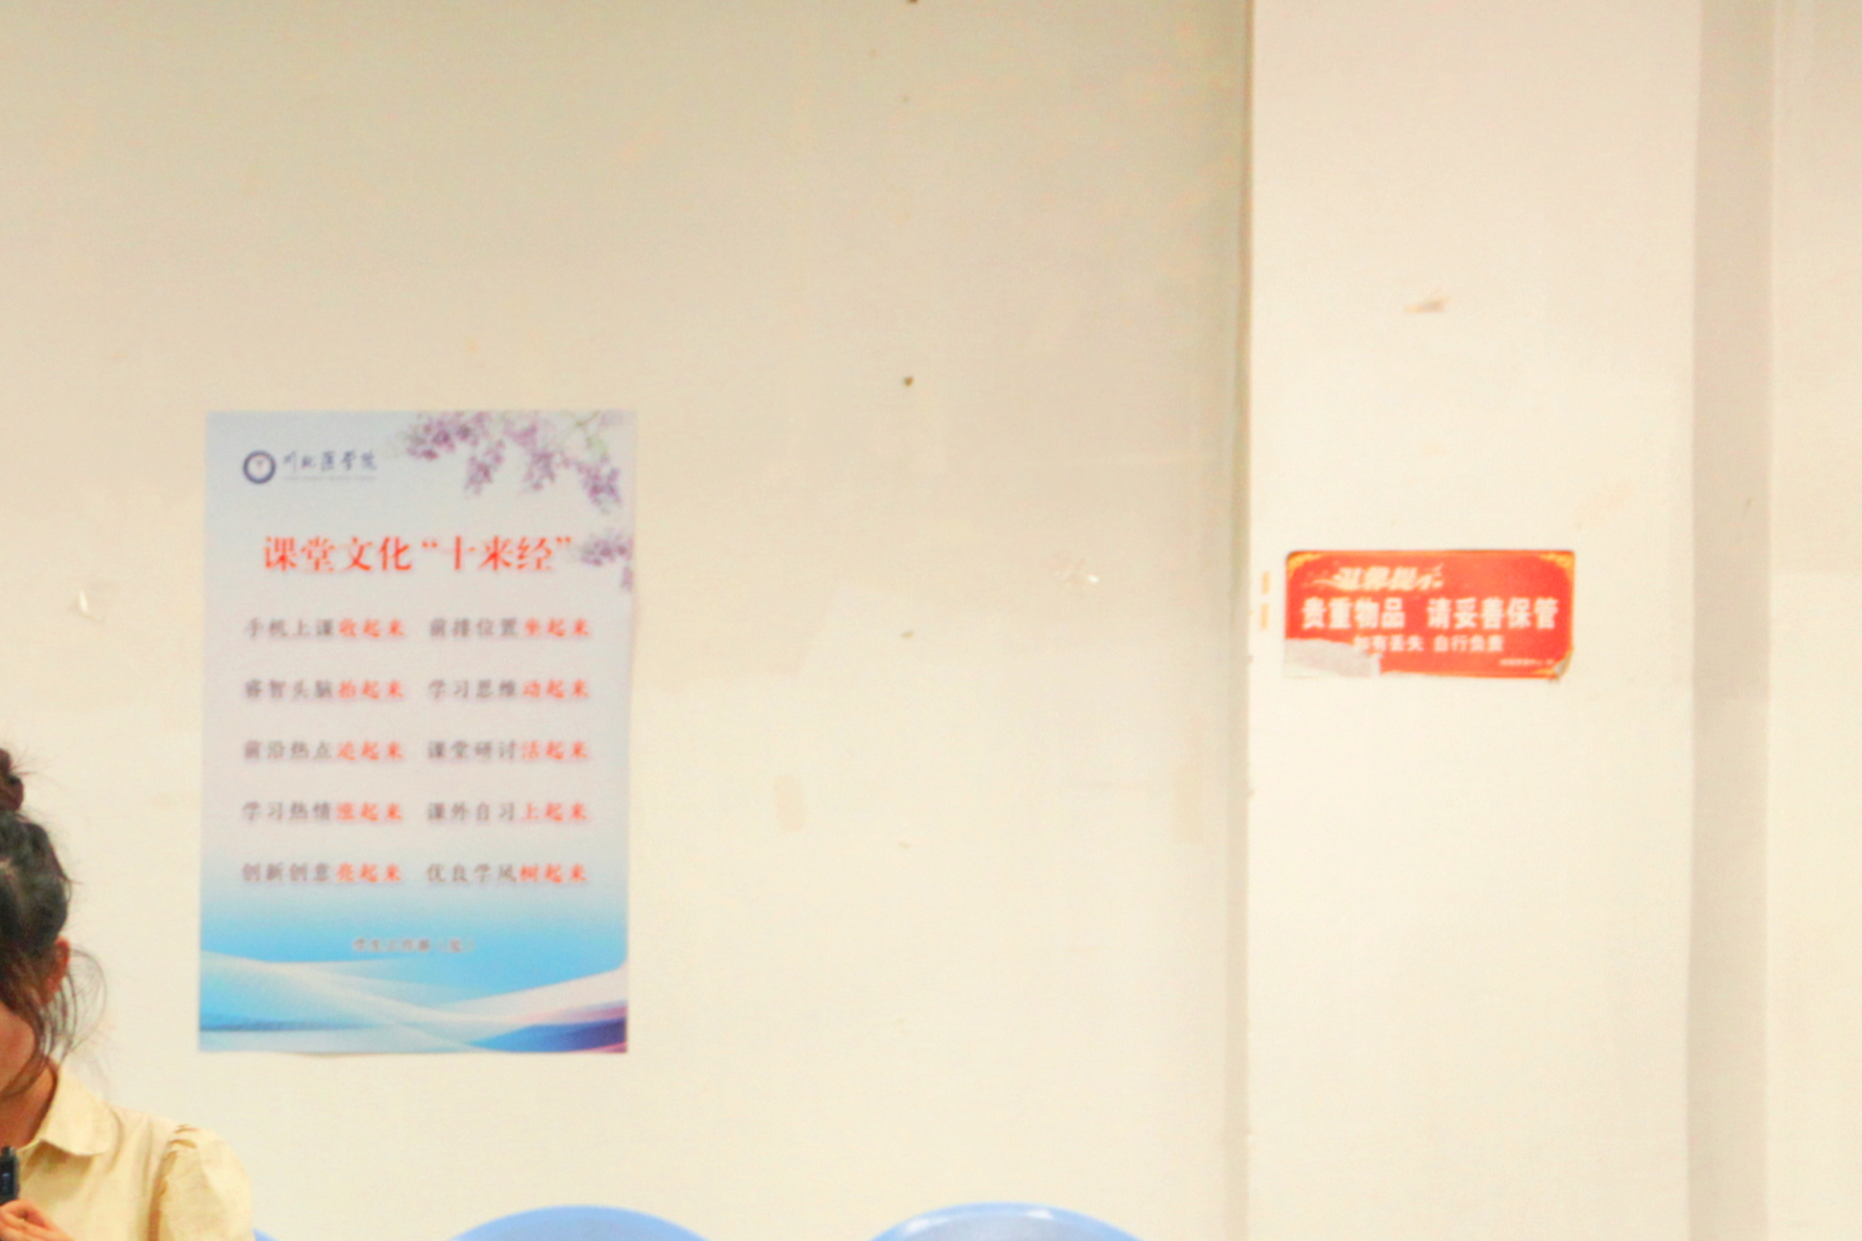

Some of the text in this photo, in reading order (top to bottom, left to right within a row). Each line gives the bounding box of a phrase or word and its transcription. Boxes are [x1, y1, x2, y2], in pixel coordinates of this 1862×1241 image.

[1302, 596, 1559, 629] 贵重物品 请妥善保管
[245, 618, 406, 638] 手机上课收起来
[1434, 634, 1504, 652] 自行负责
[427, 801, 589, 822] 课外自习上起来
